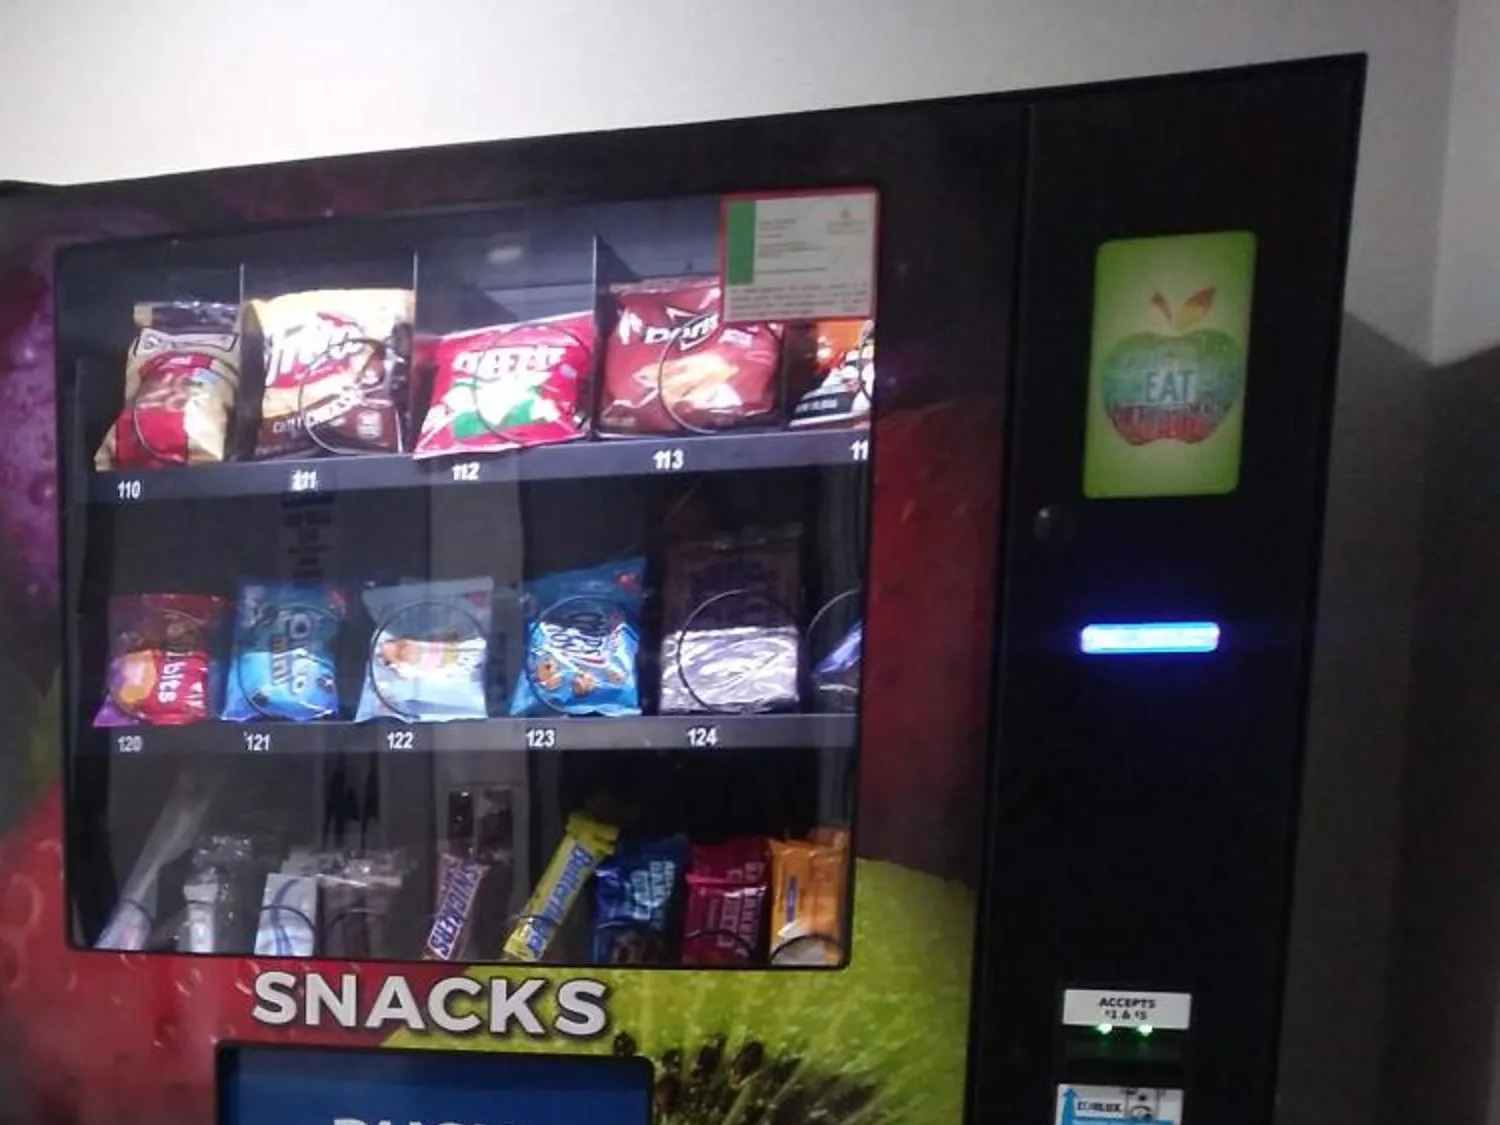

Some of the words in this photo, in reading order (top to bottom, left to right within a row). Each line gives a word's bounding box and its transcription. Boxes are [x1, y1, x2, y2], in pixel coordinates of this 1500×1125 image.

[1145, 371, 1196, 402] EAT
[653, 449, 684, 470] 113
[850, 439, 870, 461] 11
[452, 462, 480, 481] 112
[117, 480, 142, 499] 110
[117, 735, 143, 753] 120
[245, 732, 271, 751] 121
[387, 731, 413, 751] 122
[525, 729, 556, 748] 123
[687, 728, 719, 747] 124
[429, 862, 484, 958] SNICKERS
[252, 971, 608, 1036] SNACKS
[1099, 997, 1157, 1009] ACCEPTS
